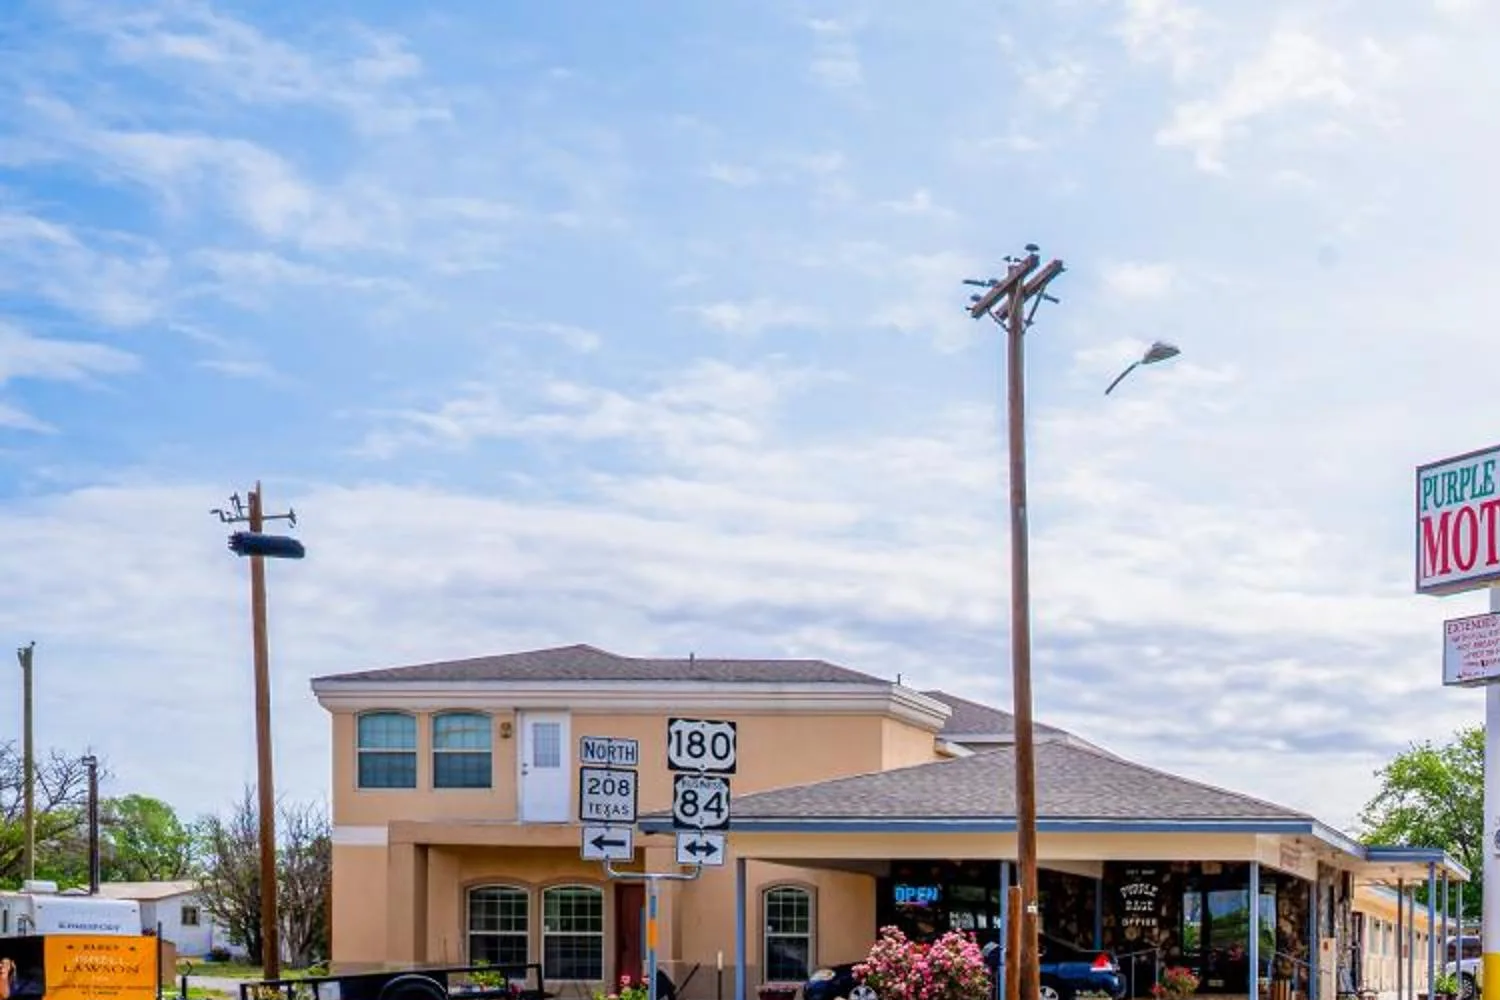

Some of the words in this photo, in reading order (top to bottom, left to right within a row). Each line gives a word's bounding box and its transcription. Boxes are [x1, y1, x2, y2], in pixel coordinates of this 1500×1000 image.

[1422, 459, 1496, 512] PURPLE
[584, 741, 635, 761] NORTH
[674, 729, 731, 761] 180
[588, 778, 630, 797] 208
[588, 803, 629, 816] TEXAS
[679, 789, 724, 819] 84
[895, 886, 939, 901] OPEN
[63, 964, 140, 974] LAWSON
